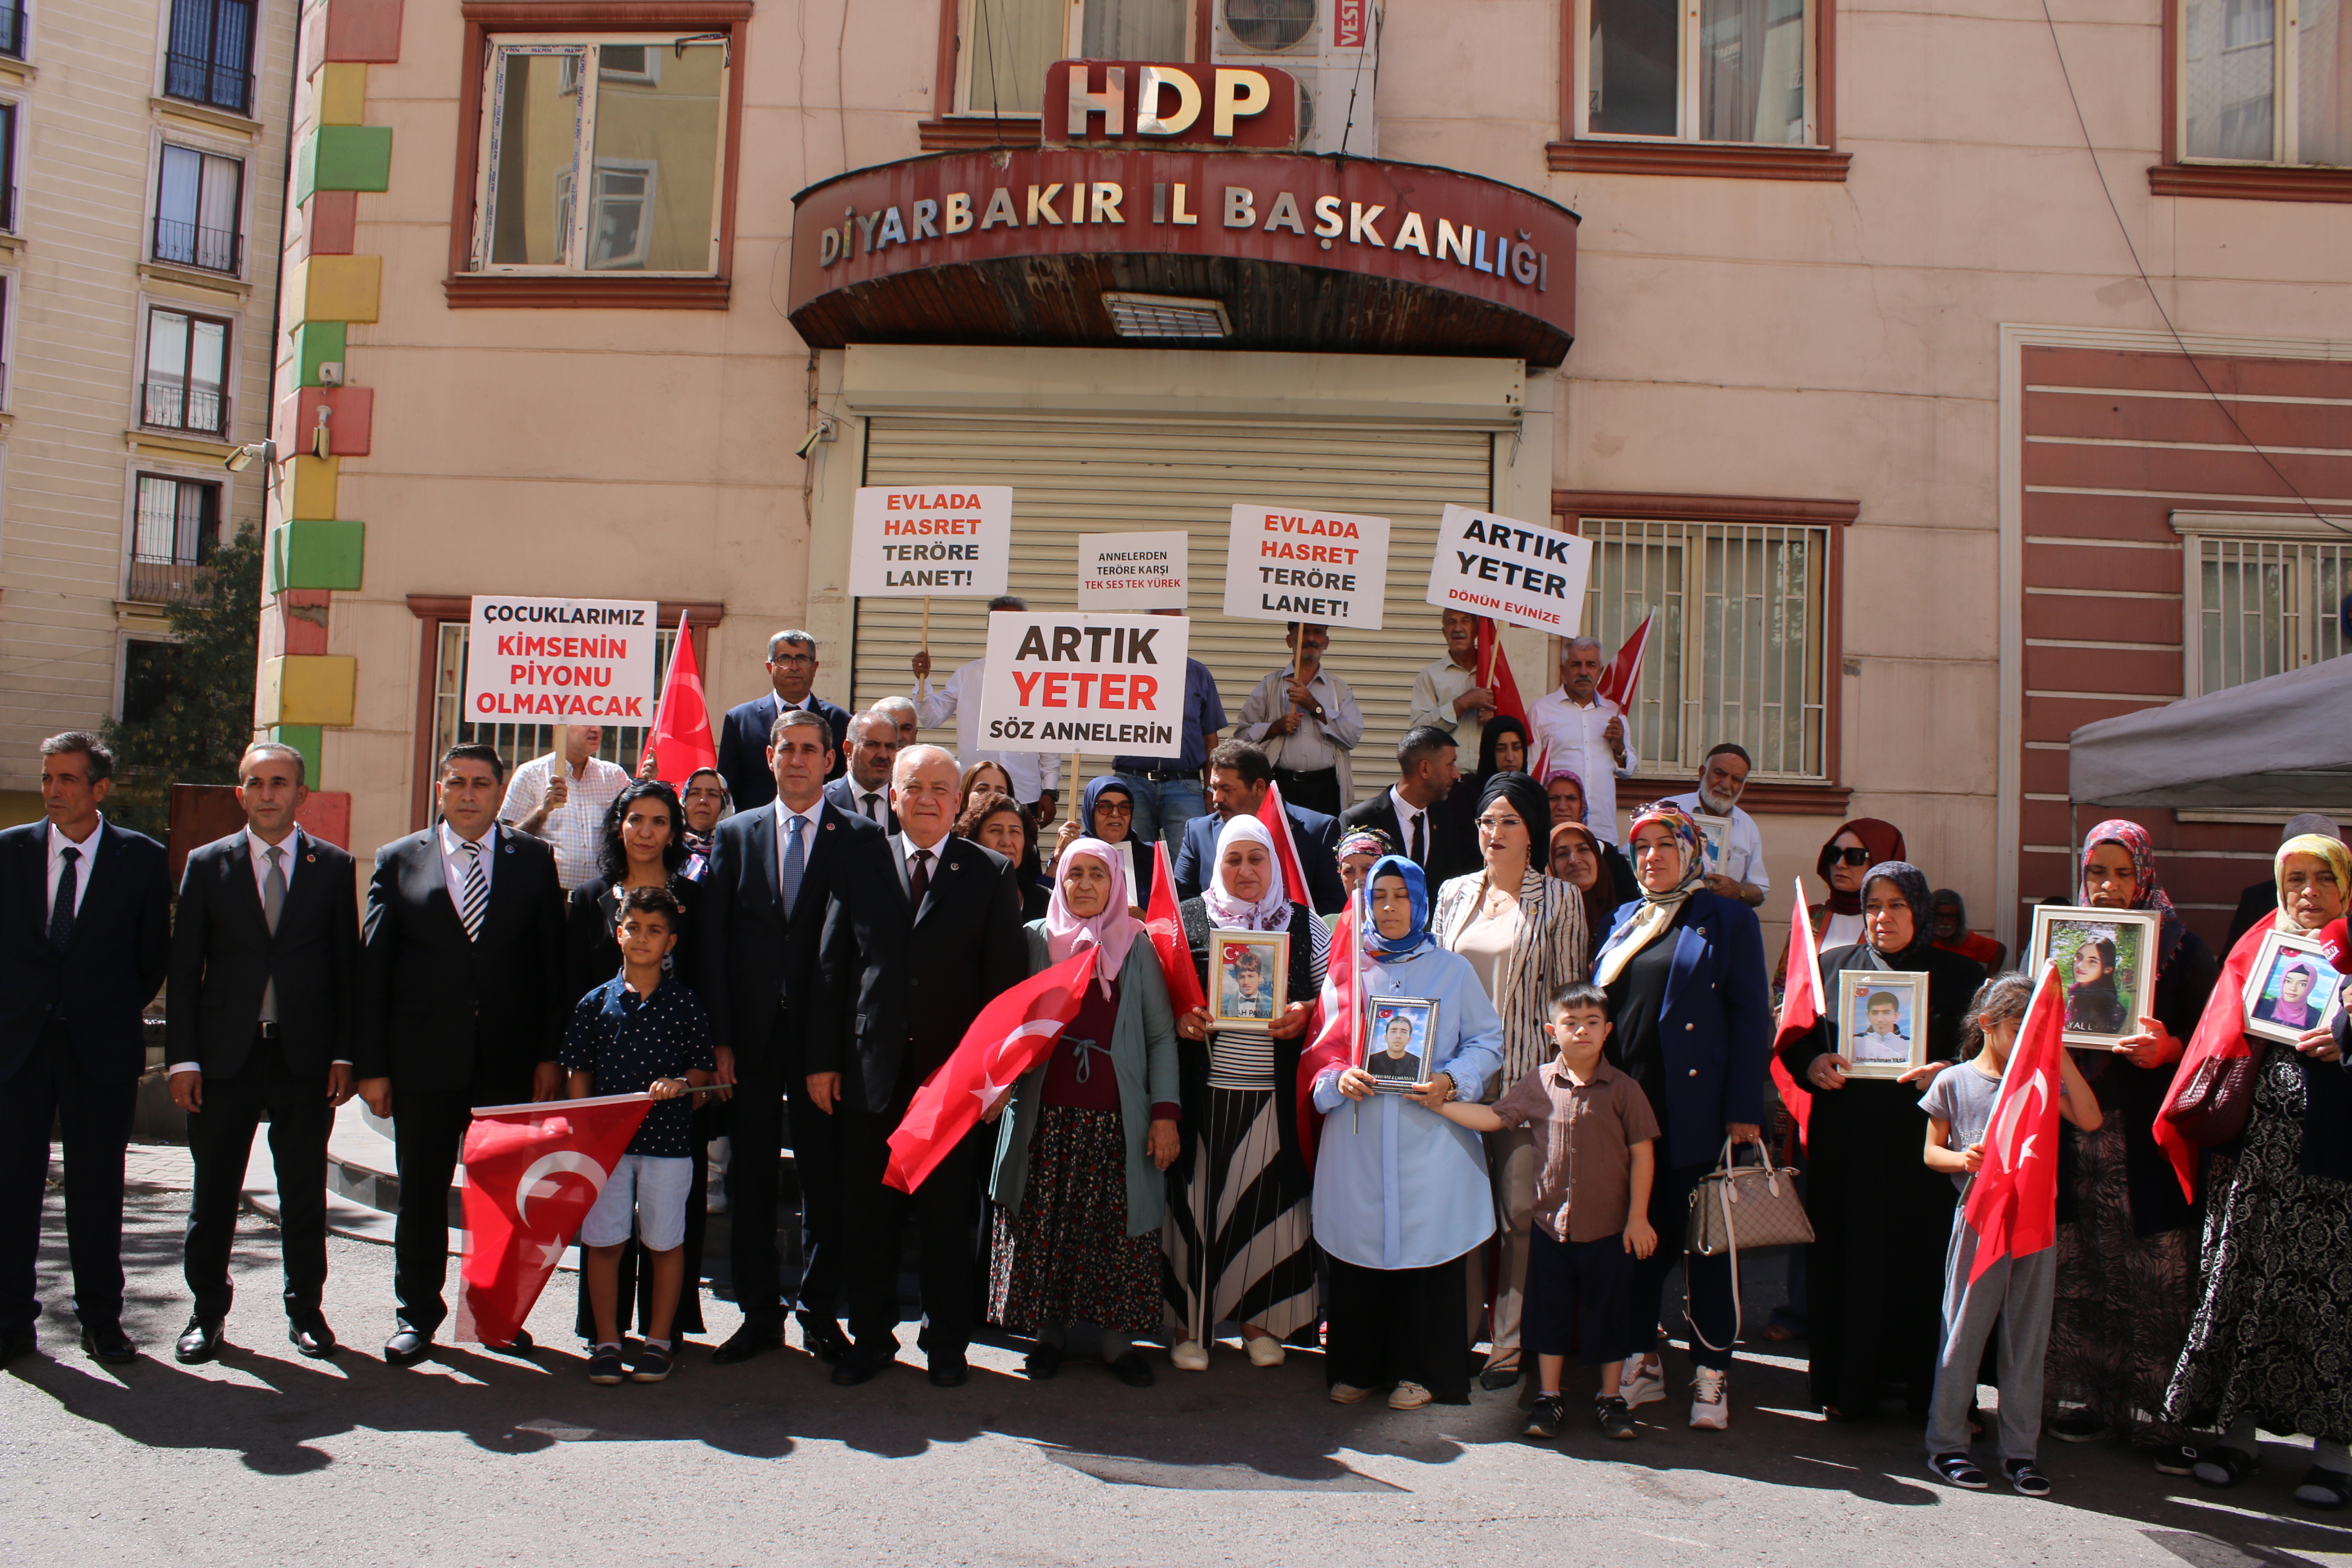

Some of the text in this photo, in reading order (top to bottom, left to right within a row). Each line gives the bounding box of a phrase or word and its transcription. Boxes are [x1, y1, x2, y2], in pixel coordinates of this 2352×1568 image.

[1068, 65, 1270, 139] HDP
[820, 182, 1125, 268] DİYARBAKIR
[1224, 186, 1547, 291] BAŞKANLIĞI
[887, 494, 981, 510] EVLADA
[885, 519, 981, 535] HASRET
[1264, 514, 1360, 539] EVLADA
[883, 542, 979, 561] TERÖRE
[1261, 540, 1359, 565] HASRET
[1462, 519, 1571, 565] ARTIK
[1099, 551, 1167, 562] ANNELERDEN
[886, 571, 972, 587] LANET!
[1097, 564, 1168, 576] TERÖRE KARŞI
[1259, 567, 1356, 591] TERÖRE
[1456, 550, 1567, 600] YETER
[1085, 578, 1181, 589] TEK SES TEK YÜREK
[484, 605, 645, 625] ÇOCUKLARIMIZ
[1262, 593, 1348, 618] LANET!
[1449, 589, 1560, 625] DÖNÜN EVİNİZE
[498, 631, 627, 659] KİMSENİN
[1015, 625, 1160, 664] ARTIK
[511, 660, 612, 687] PİYONU
[1012, 671, 1159, 710] YETER
[476, 692, 643, 717] OLMAYACAK
[989, 716, 1172, 744] SÖZ ANNELERİN
